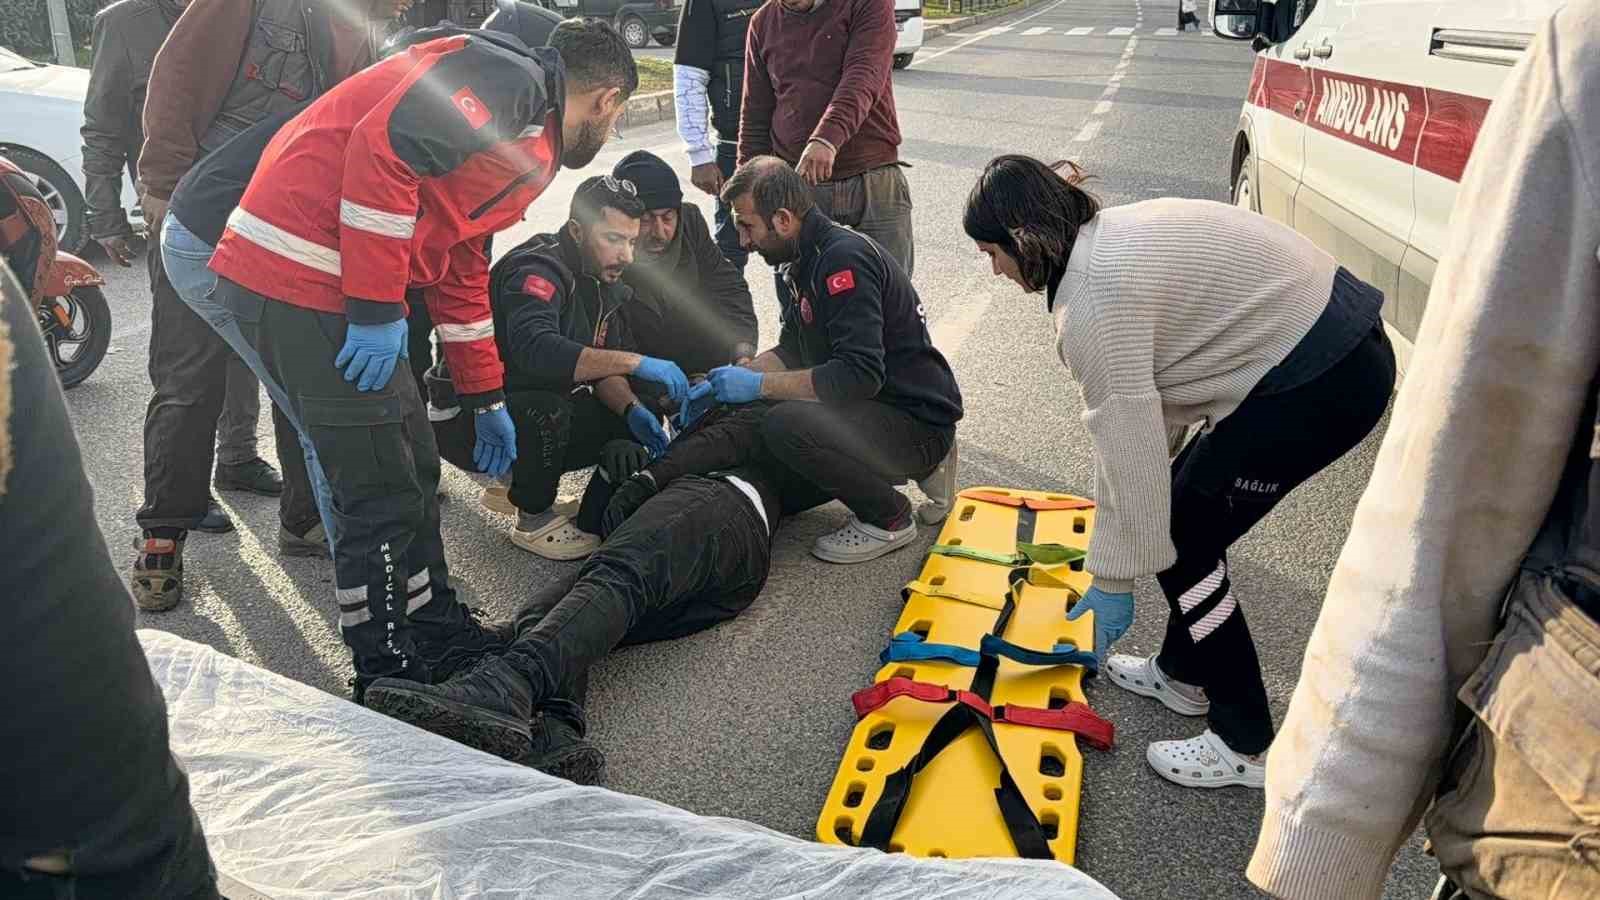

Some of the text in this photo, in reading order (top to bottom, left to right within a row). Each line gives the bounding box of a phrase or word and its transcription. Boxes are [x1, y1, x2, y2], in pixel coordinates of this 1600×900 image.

[1314, 77, 1409, 151] AMBULANS
[1234, 477, 1280, 493] SAĞLIK
[381, 542, 408, 668] MEDICAL RSCE
